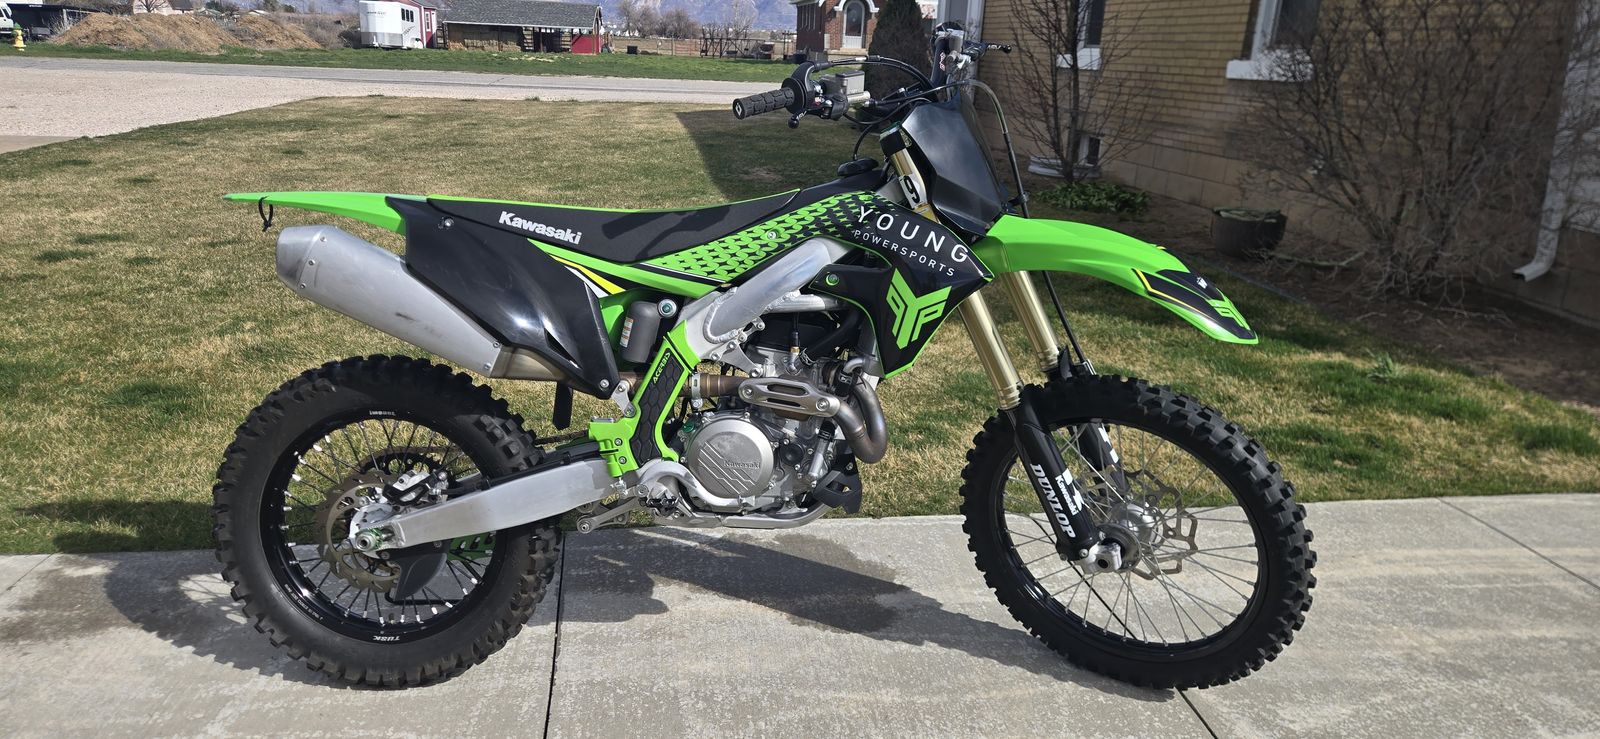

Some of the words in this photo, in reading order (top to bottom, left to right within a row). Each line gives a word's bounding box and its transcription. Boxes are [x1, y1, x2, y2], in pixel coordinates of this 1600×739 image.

[499, 211, 582, 245] Kawasaki
[857, 205, 969, 263] YOUNG
[854, 229, 955, 277] POWERSPORTS
[724, 461, 760, 470] Kawasaki
[1030, 463, 1077, 538] DUNLOP
[1055, 474, 1079, 516] Kawasaki
